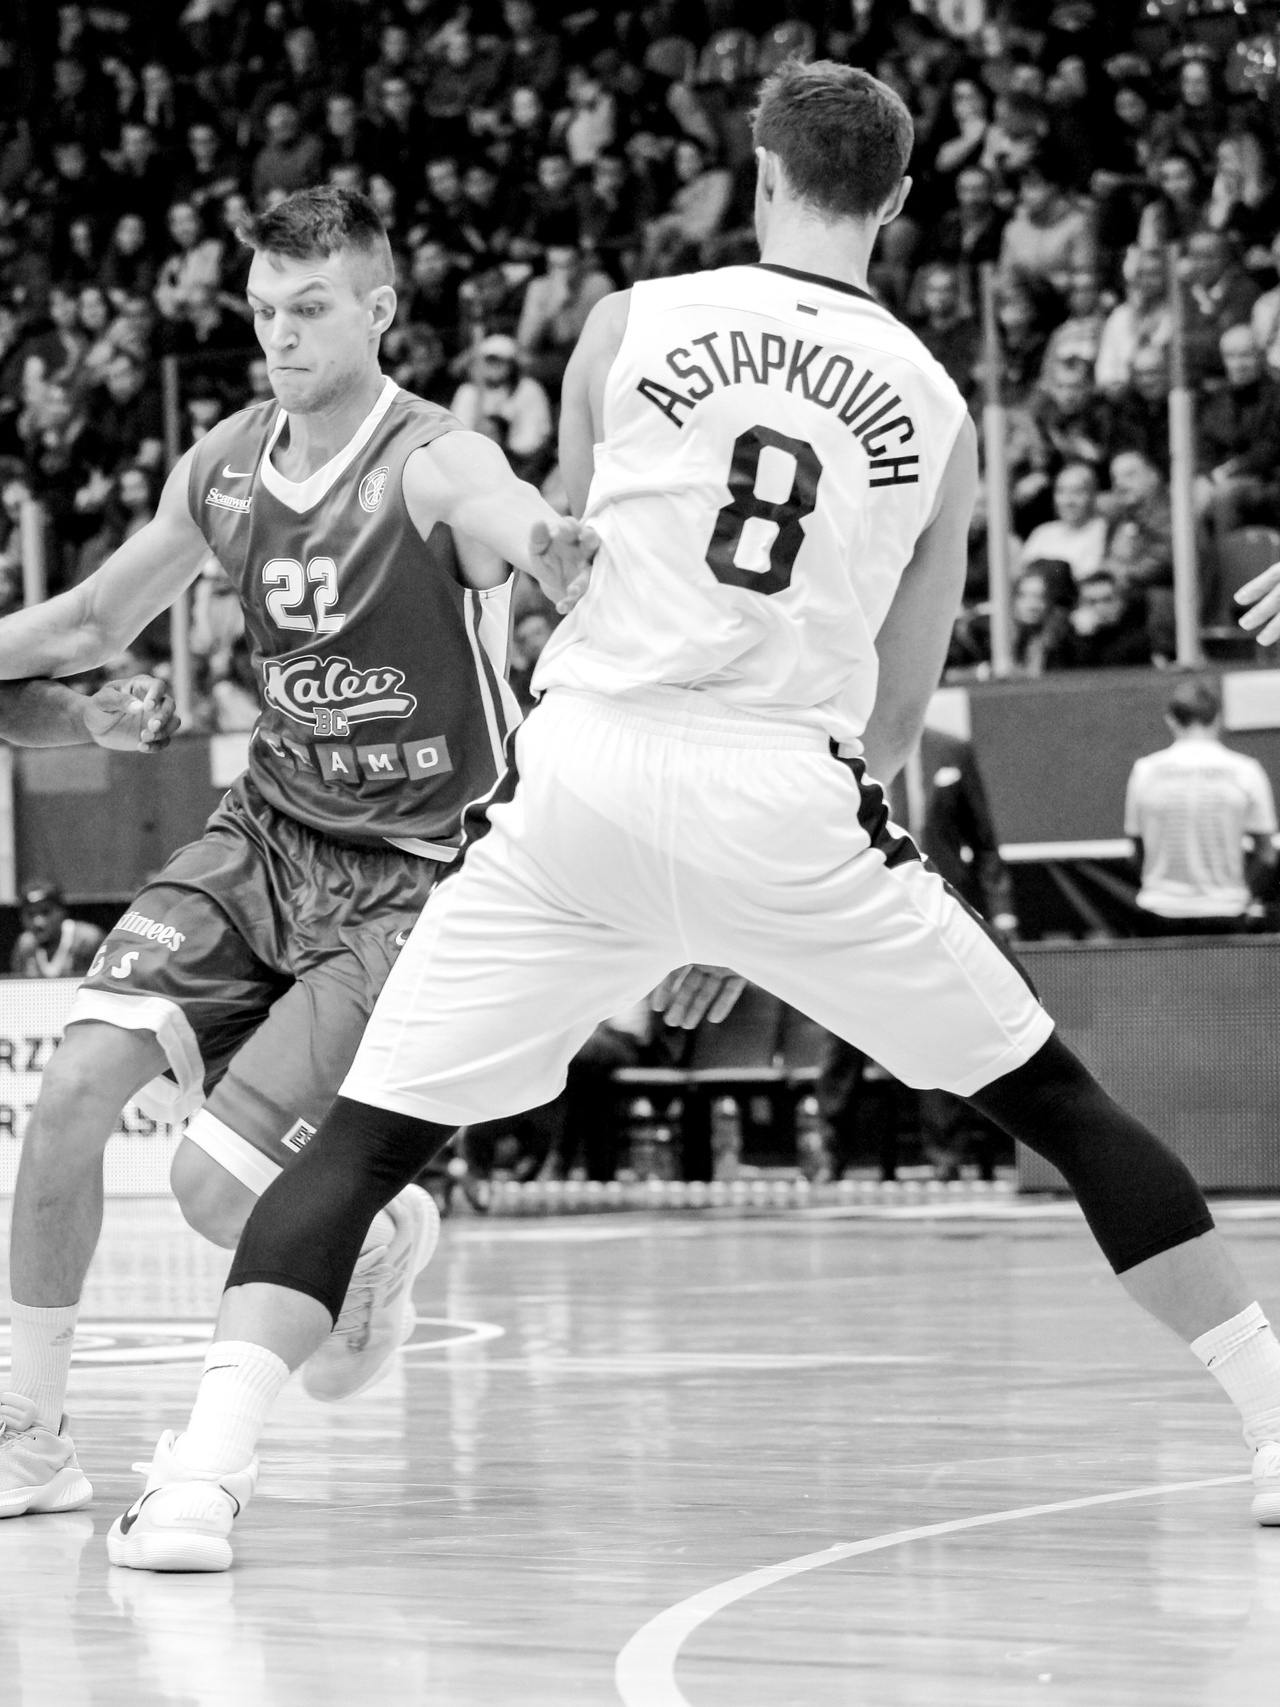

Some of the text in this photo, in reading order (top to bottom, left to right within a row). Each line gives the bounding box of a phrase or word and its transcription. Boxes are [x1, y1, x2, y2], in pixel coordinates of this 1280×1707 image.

[636, 330, 920, 489] ASTAPKOVICH
[705, 424, 823, 596] 8
[262, 556, 347, 634] 22
[313, 707, 350, 736] BC
